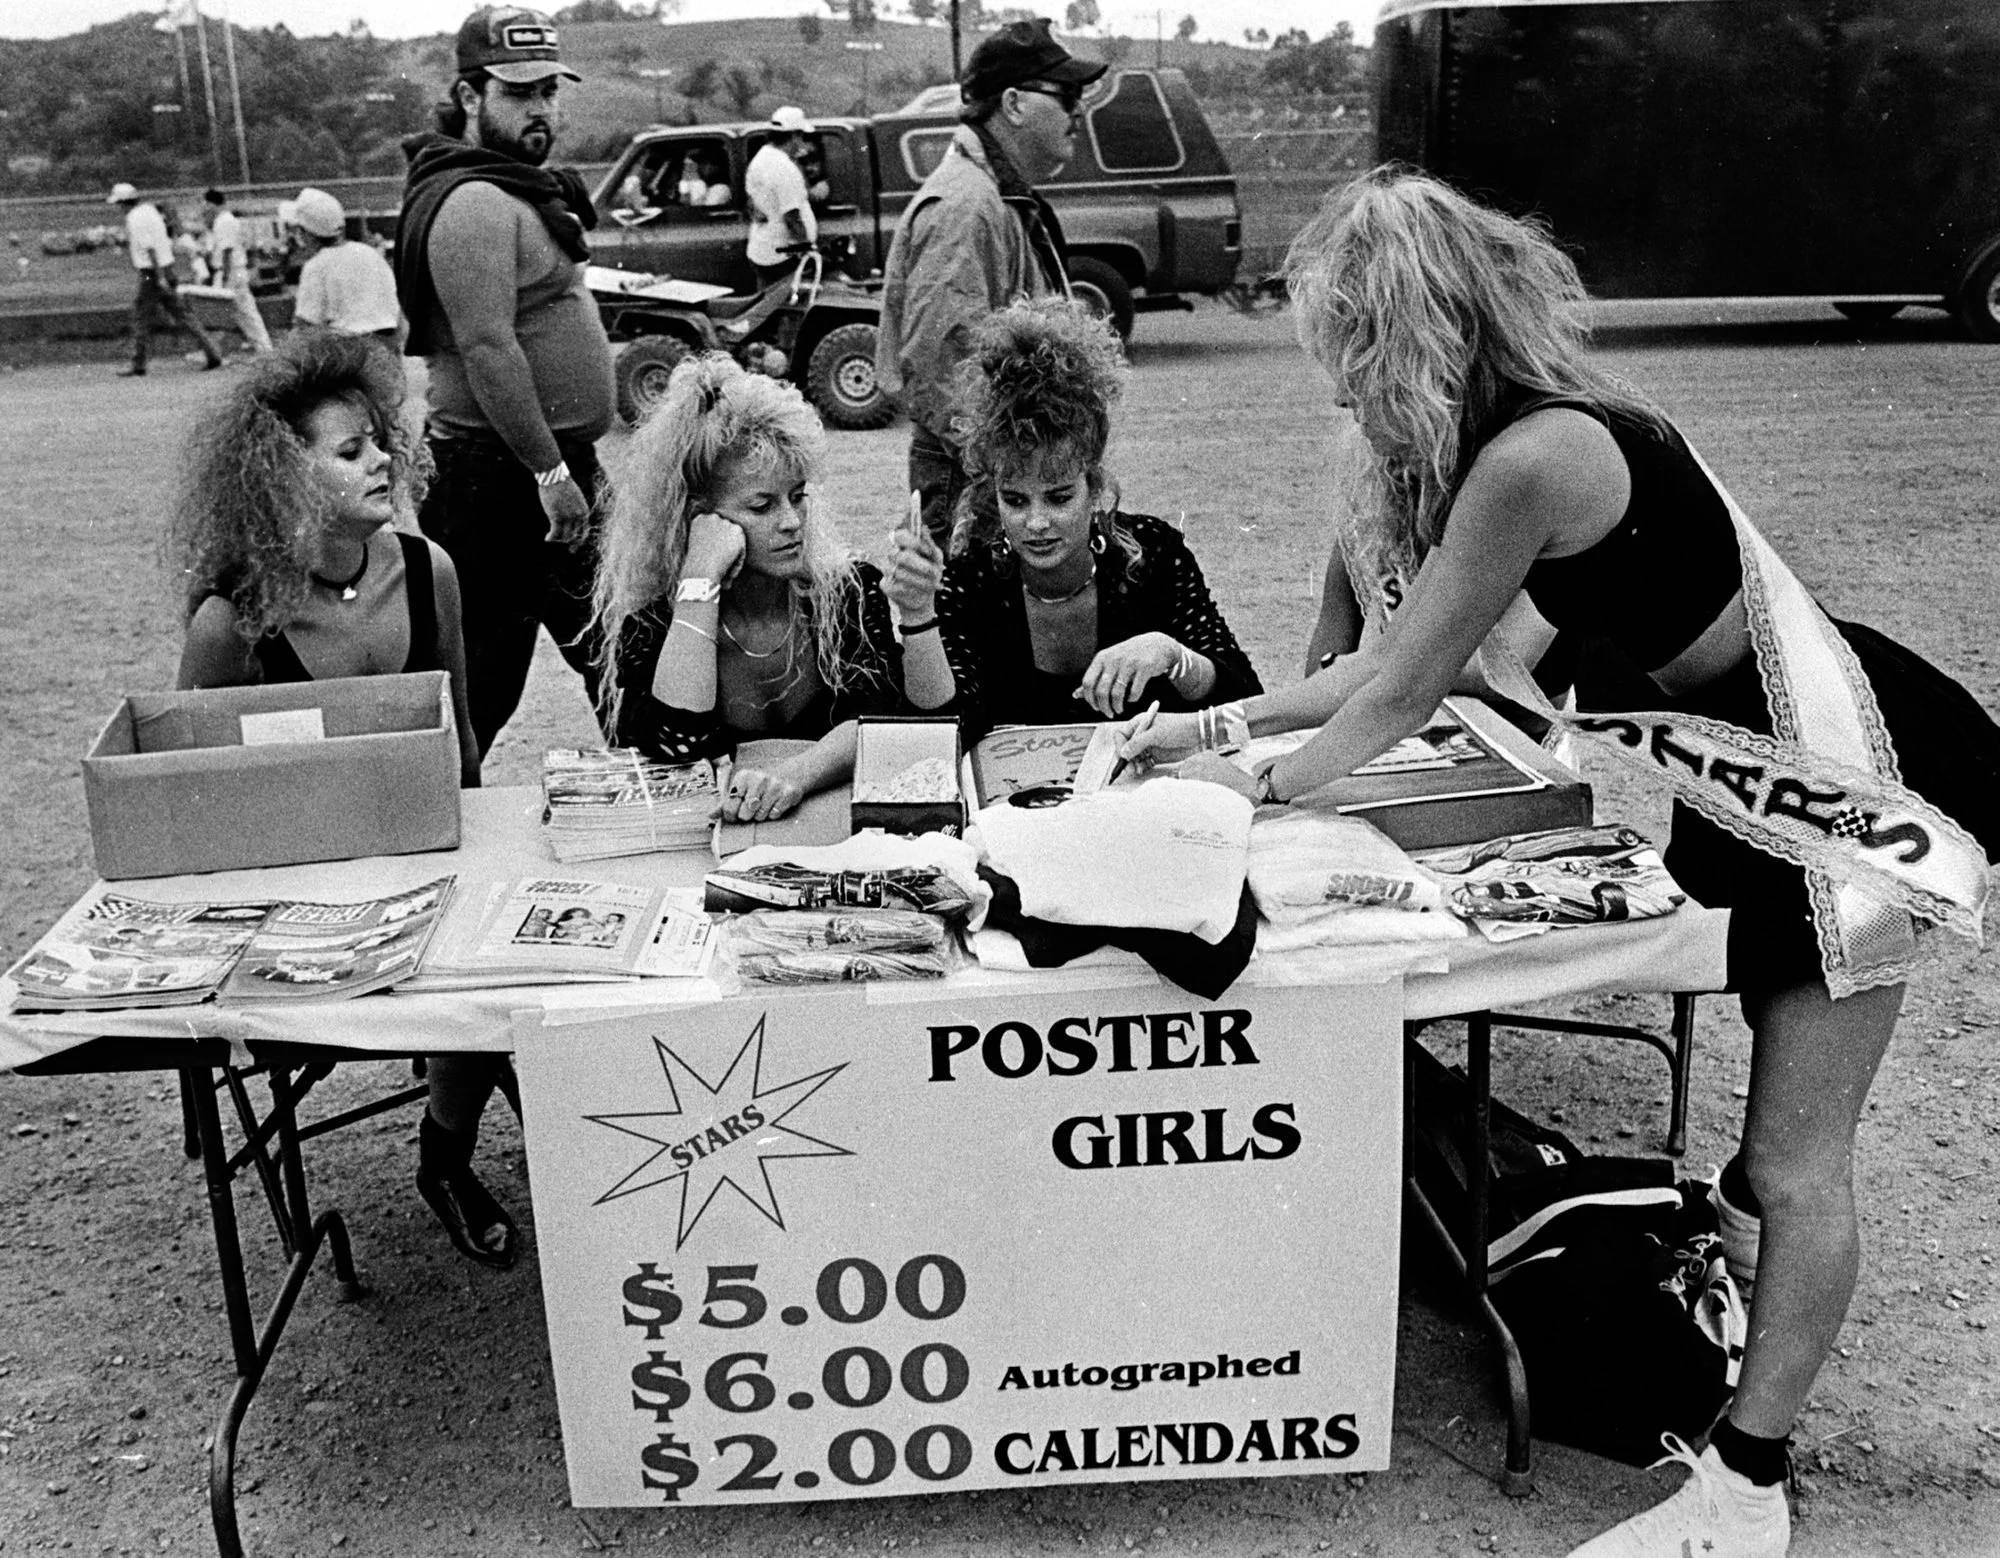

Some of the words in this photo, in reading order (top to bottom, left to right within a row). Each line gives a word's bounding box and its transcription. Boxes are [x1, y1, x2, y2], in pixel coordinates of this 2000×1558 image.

[927, 1009, 1260, 1082] POSTER
[670, 1104, 766, 1170] STARS
[1052, 1103, 1301, 1169] GIRLS
[622, 1254, 967, 1340] $5.00
[631, 1343, 970, 1423] $6.00
[998, 1350, 1300, 1391] Autographed
[640, 1424, 973, 1501] $2.00
[994, 1413, 1360, 1475] CALENDARS
